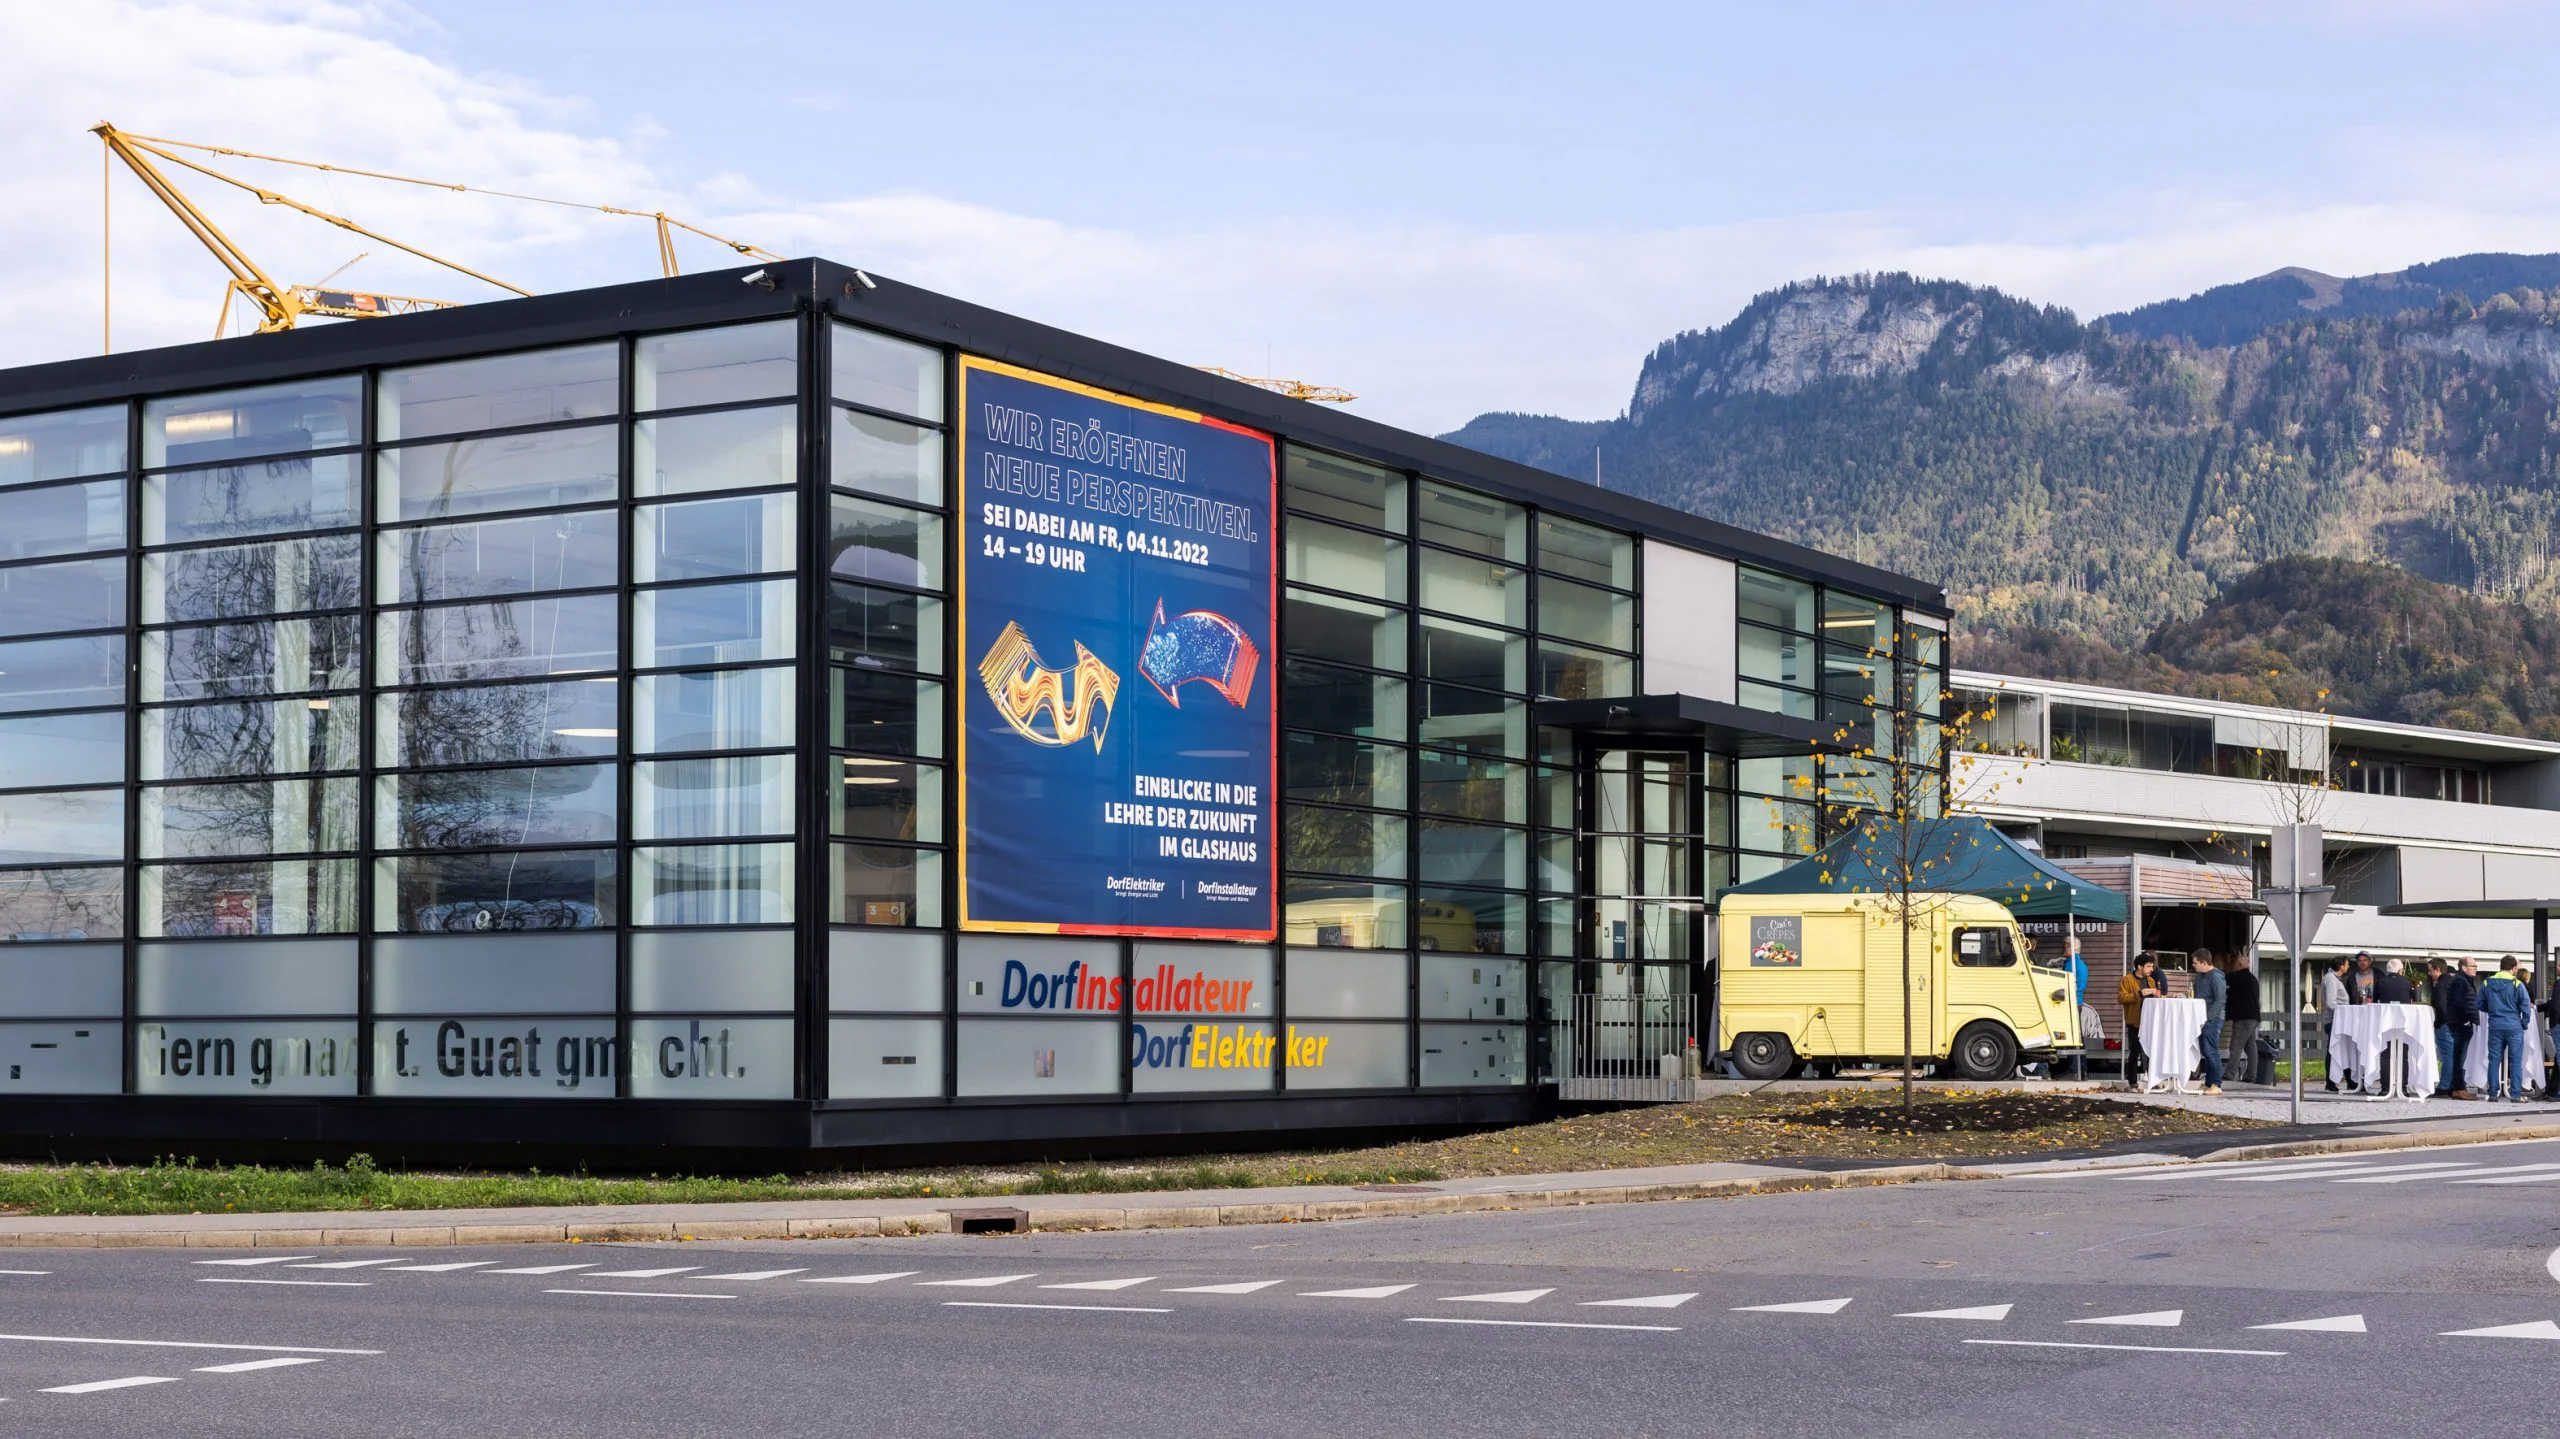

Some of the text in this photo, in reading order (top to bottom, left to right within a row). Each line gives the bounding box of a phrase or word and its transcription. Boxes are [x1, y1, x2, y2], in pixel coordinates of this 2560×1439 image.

[985, 403, 1186, 482] WIR ERÖFFNEN
[984, 452, 1258, 543] NEUE PERSPEKTIVEN.
[983, 502, 1209, 566] SEI DABEI AM FR, 04.11.2022
[983, 534, 1005, 559] 14
[1025, 542, 1046, 565] 19
[1049, 546, 1086, 573] UHR
[1135, 774, 1257, 807] EINBLICKE IN DIE
[1104, 802, 1257, 834] LEHRE DER ZUKUNFT
[1159, 835, 1257, 863] IM GLASHAUS
[1106, 876, 1165, 892] DorfElektriker
[1197, 880, 1258, 896] DorfInstallateur
[2066, 922, 2107, 933] ood
[1002, 960, 1252, 1012] DorfInsallateur
[437, 1020, 541, 1077] Guat
[1131, 1023, 1328, 1069] DorfElektrker
